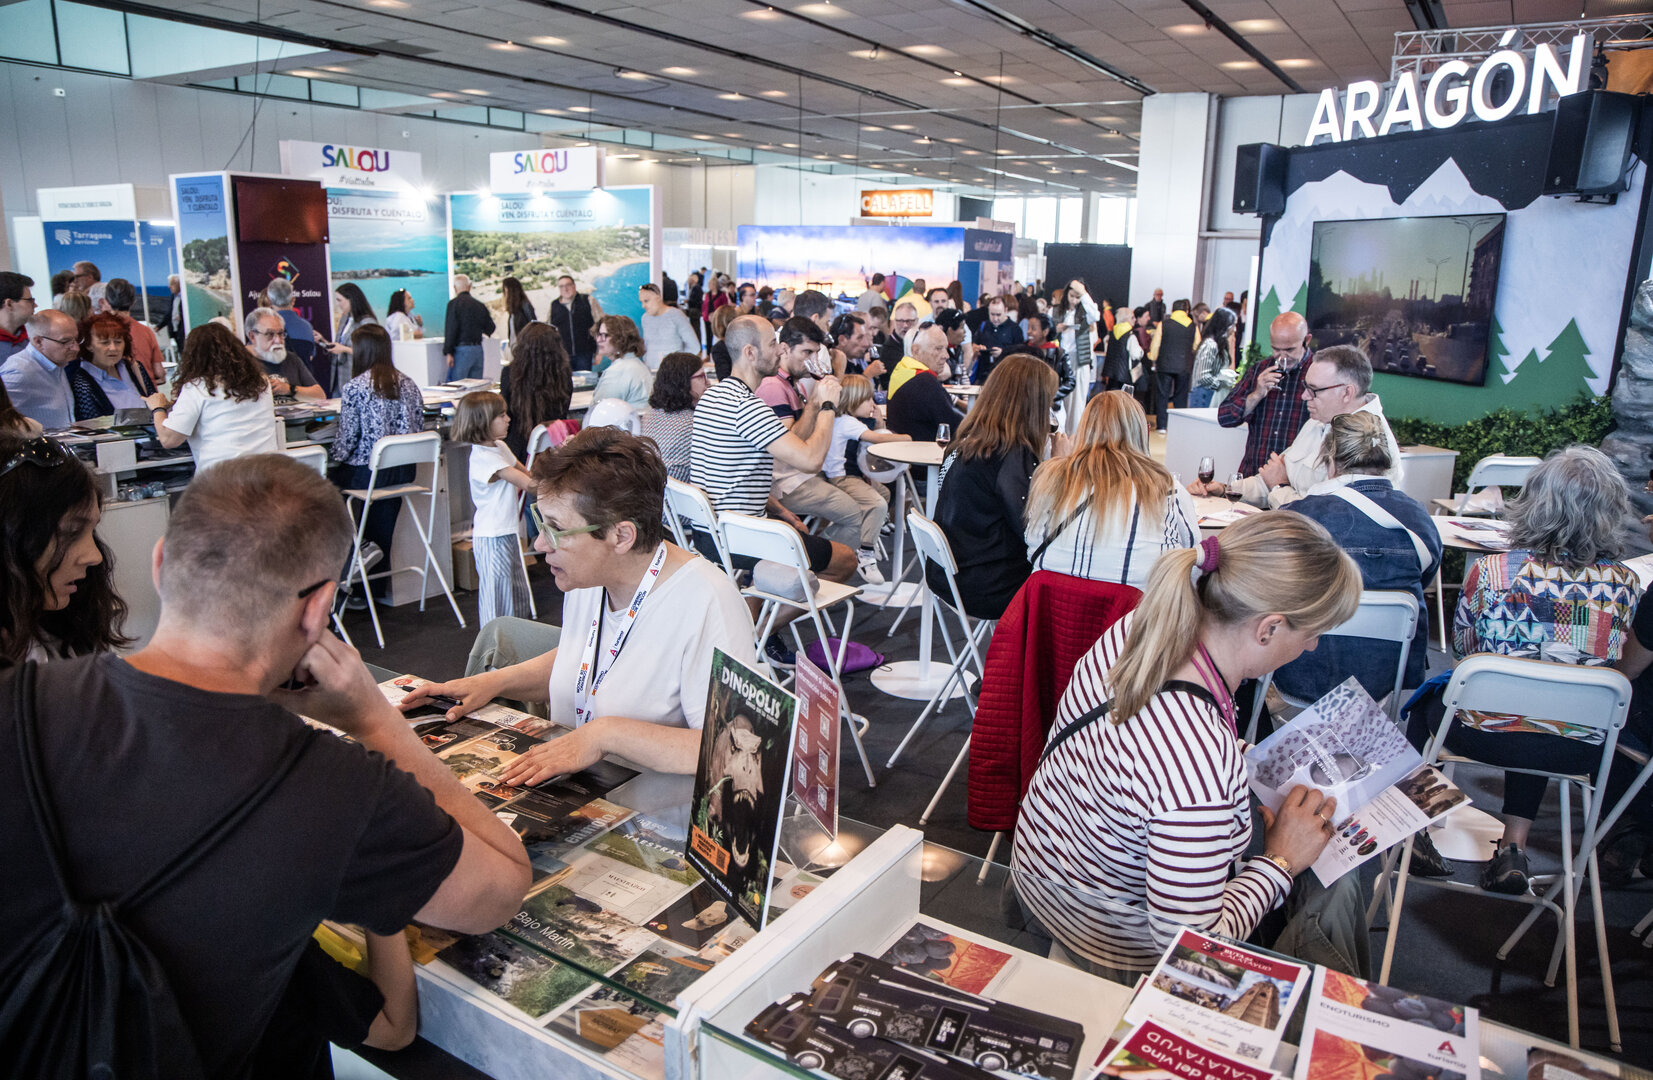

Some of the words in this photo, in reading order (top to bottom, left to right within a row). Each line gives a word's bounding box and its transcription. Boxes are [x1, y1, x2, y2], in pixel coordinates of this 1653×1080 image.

[1304, 28, 1586, 147] ARAGÓN
[322, 145, 389, 172] SALOU
[514, 151, 568, 174] SALOU
[332, 206, 372, 216] DISFRUTA
[861, 194, 932, 212] CALAFELL
[73, 231, 112, 240] Tarragona
[301, 289, 321, 297] Salou
[721, 666, 781, 720] DINÓPOLIS
[623, 833, 686, 860] MAESTRAZ
[513, 910, 541, 931] Bajo
[539, 926, 576, 950] Martín
[1320, 1001, 1390, 1029] ENOTURISMO
[1140, 1044, 1174, 1066] vino
[1174, 1061, 1202, 1077] del
